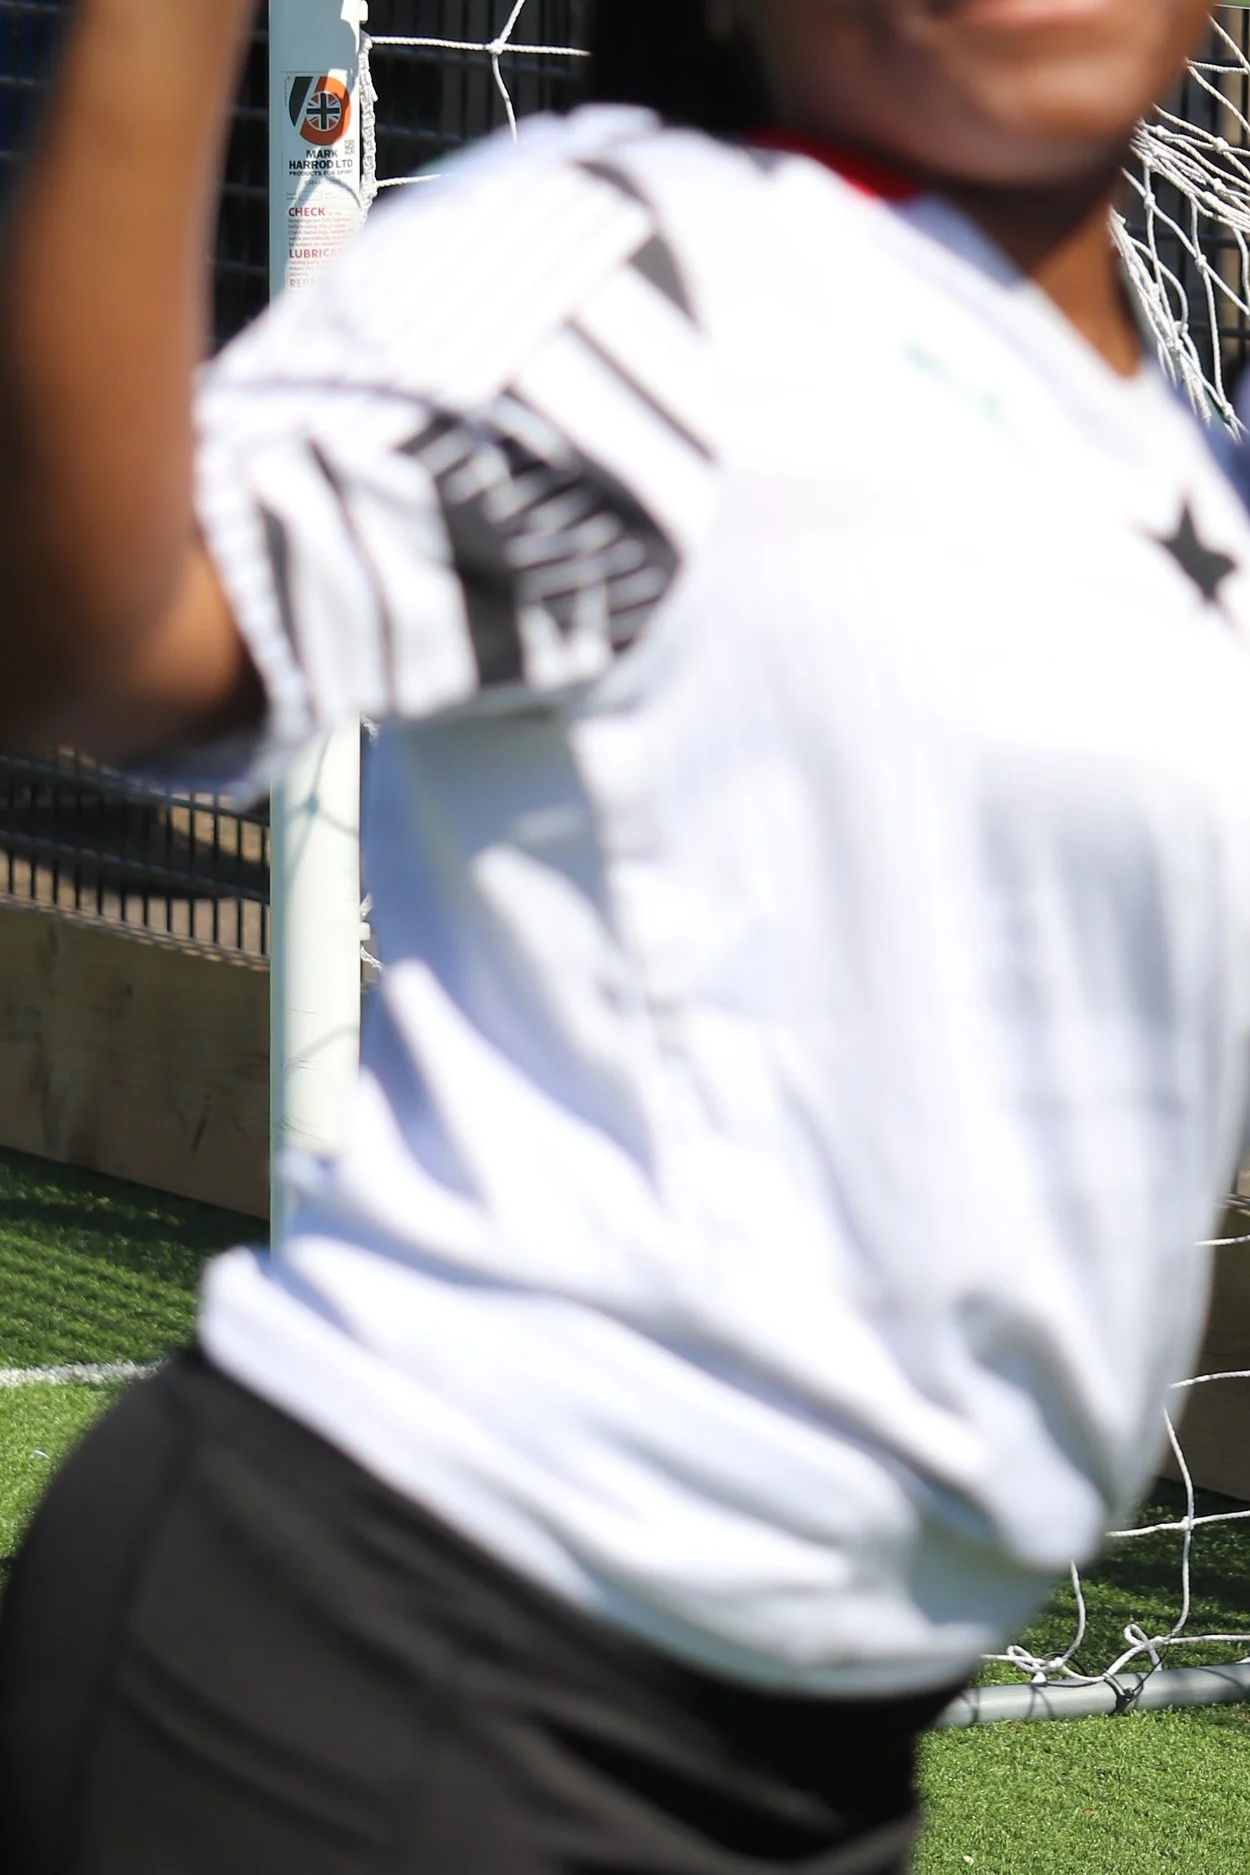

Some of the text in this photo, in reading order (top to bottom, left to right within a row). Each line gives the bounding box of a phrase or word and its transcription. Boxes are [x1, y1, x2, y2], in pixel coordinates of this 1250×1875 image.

[305, 149, 338, 159] MARK
[288, 159, 353, 170] HARROD LTD
[288, 207, 326, 217] CHECK
